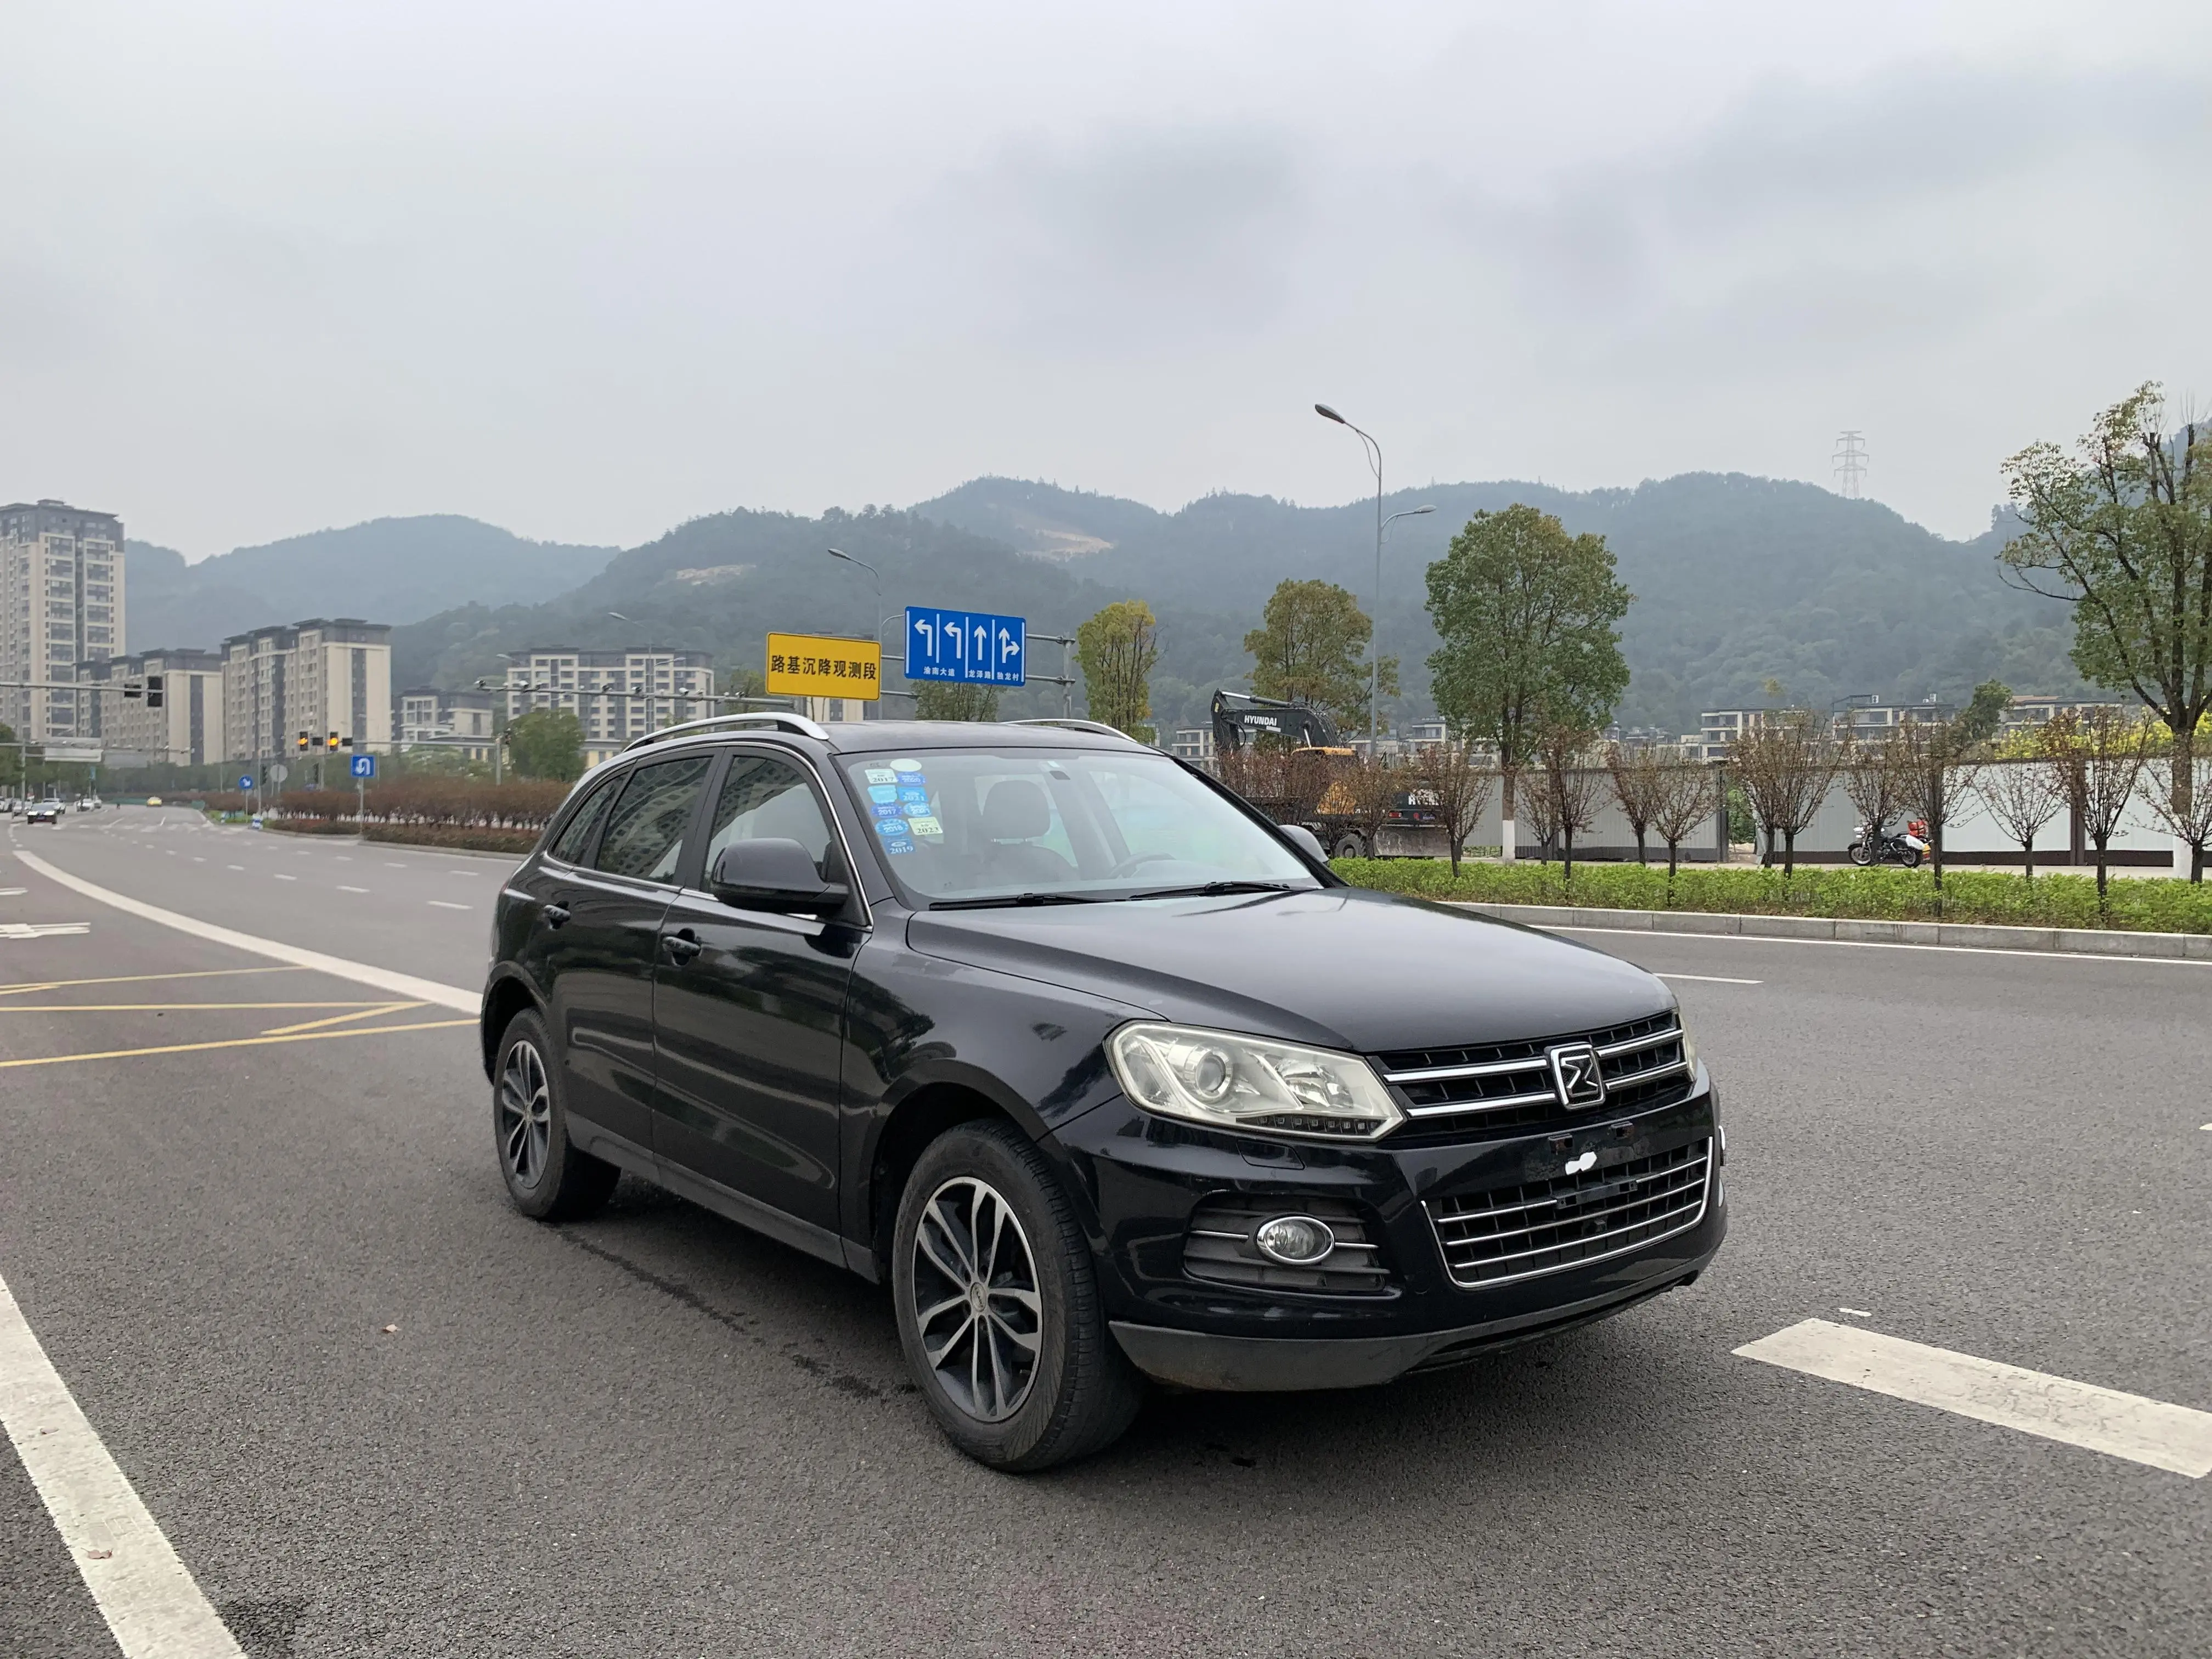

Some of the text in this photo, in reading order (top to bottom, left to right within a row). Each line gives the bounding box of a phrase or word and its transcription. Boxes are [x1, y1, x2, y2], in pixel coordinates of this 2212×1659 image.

[771, 654, 877, 680] 路基沉降观测段
[1244, 715, 1277, 726] HYUNDAI
[883, 825, 903, 833] 2018
[889, 846, 913, 854] 2019
